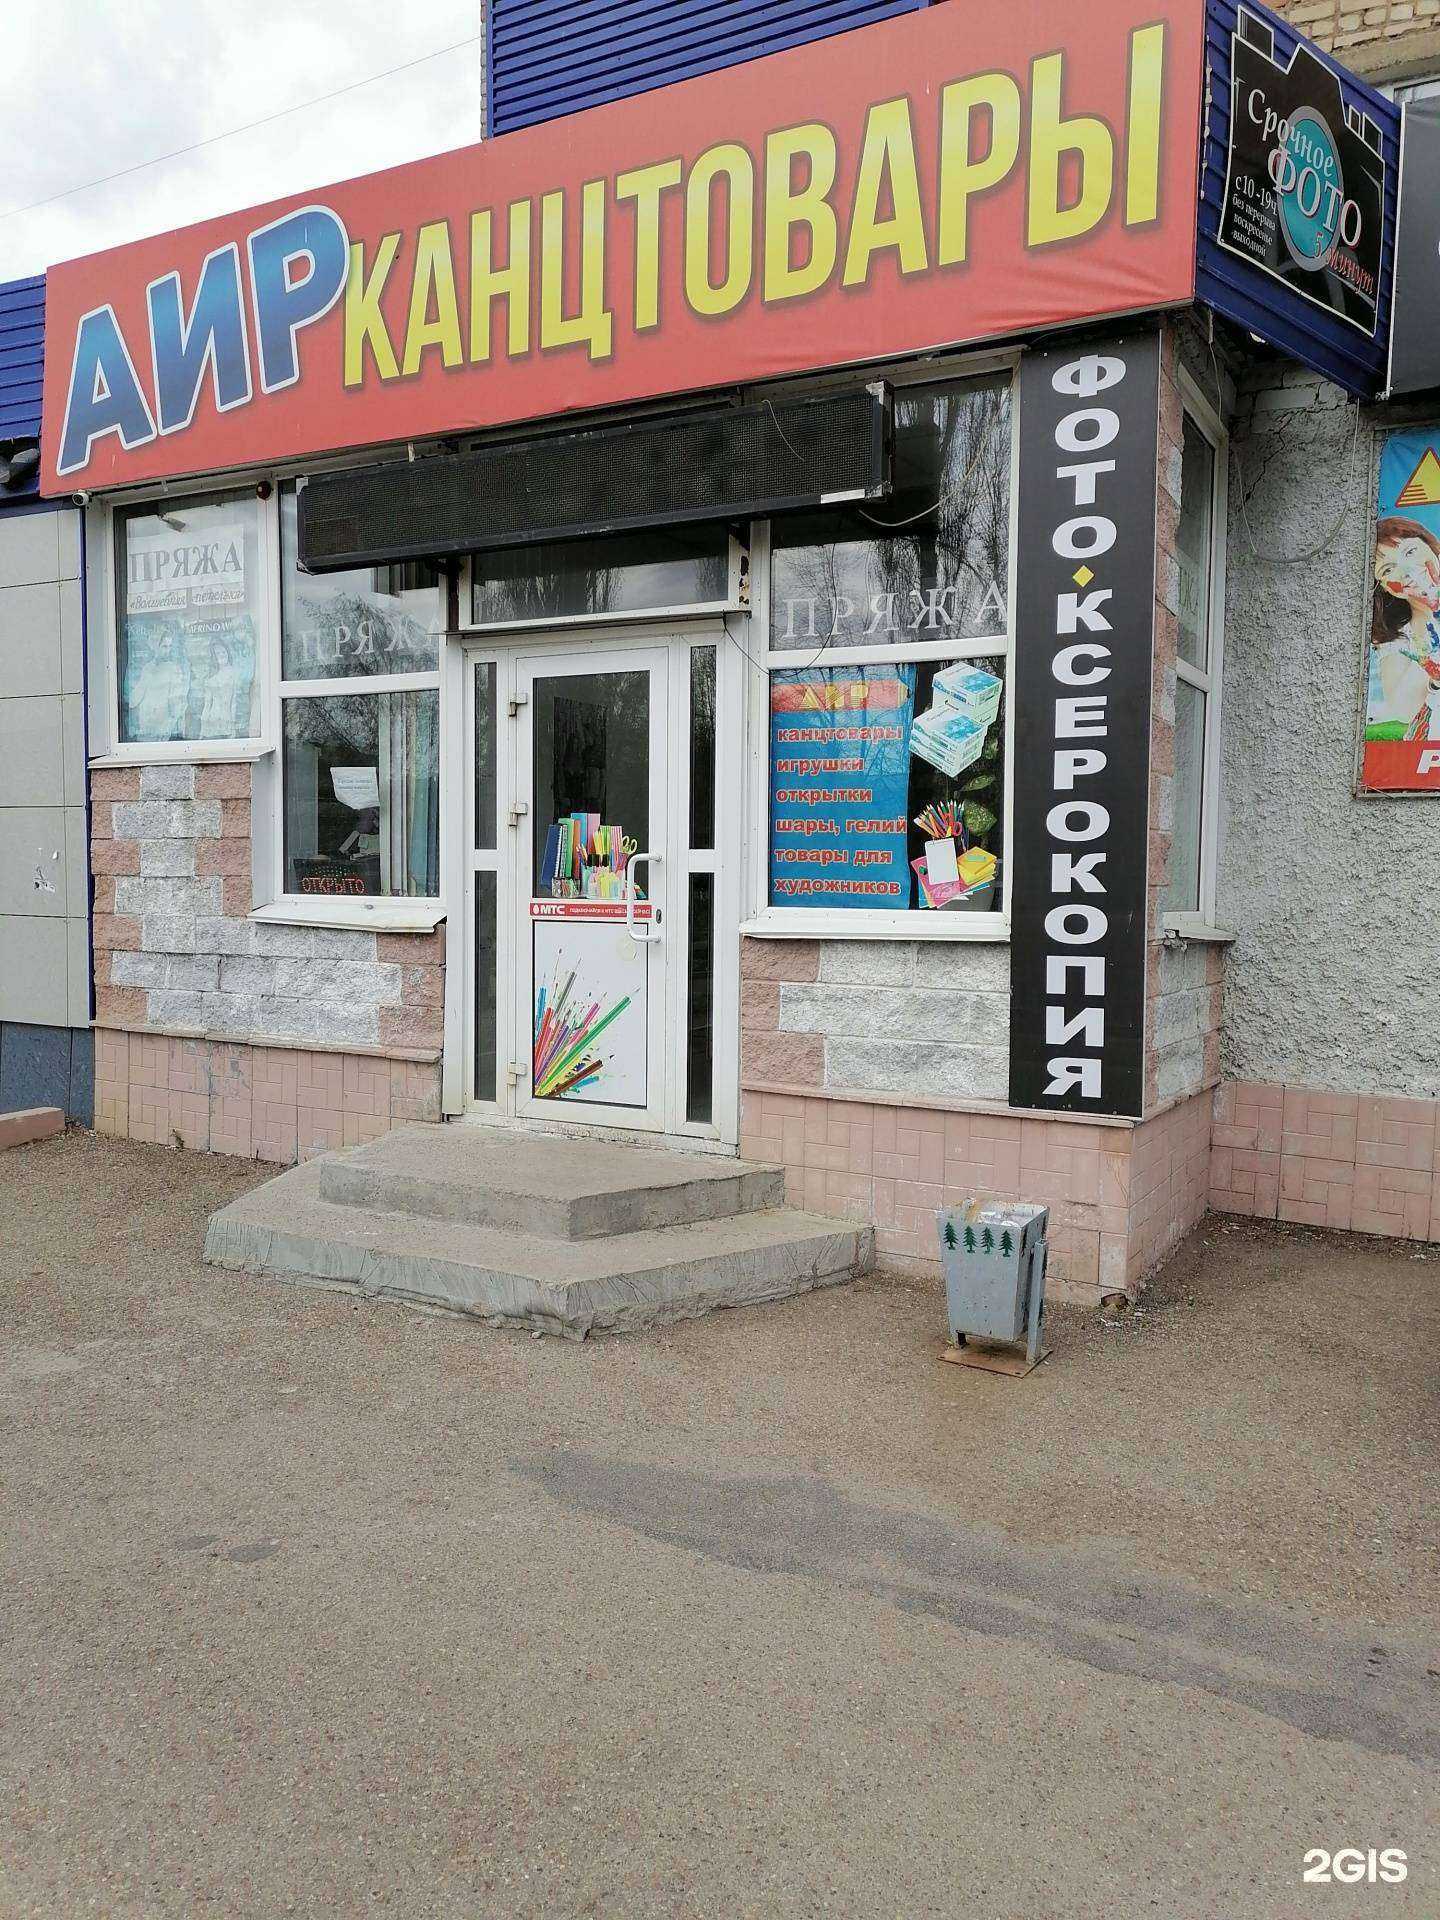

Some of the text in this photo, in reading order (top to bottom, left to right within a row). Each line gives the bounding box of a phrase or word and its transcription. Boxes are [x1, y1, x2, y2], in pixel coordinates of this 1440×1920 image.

[1248, 88, 1335, 178] Срочное
[343, 23, 1165, 388] КАНЦТОВАРЫ
[1232, 193, 1276, 232] без перерыва
[1267, 148, 1362, 247] ФОТО
[1232, 231, 1266, 257] выходной
[1313, 231, 1324, 259] 5
[57, 205, 351, 476] АИР
[1052, 354, 1127, 559] ФОТО
[128, 541, 243, 584] ПРЯЖА
[782, 580, 1007, 639] ПРЯЖА
[301, 613, 440, 661] ПРЯЖА
[776, 725, 904, 743] канцтовары
[776, 756, 864, 775] игрушки
[776, 788, 872, 806] открытки
[776, 817, 907, 836] шары, гелий
[1042, 588, 1113, 1099] КСЕРОКОПИЯ
[775, 848, 892, 865] товары для
[775, 879, 901, 896] художников
[540, 904, 566, 915] МТС
